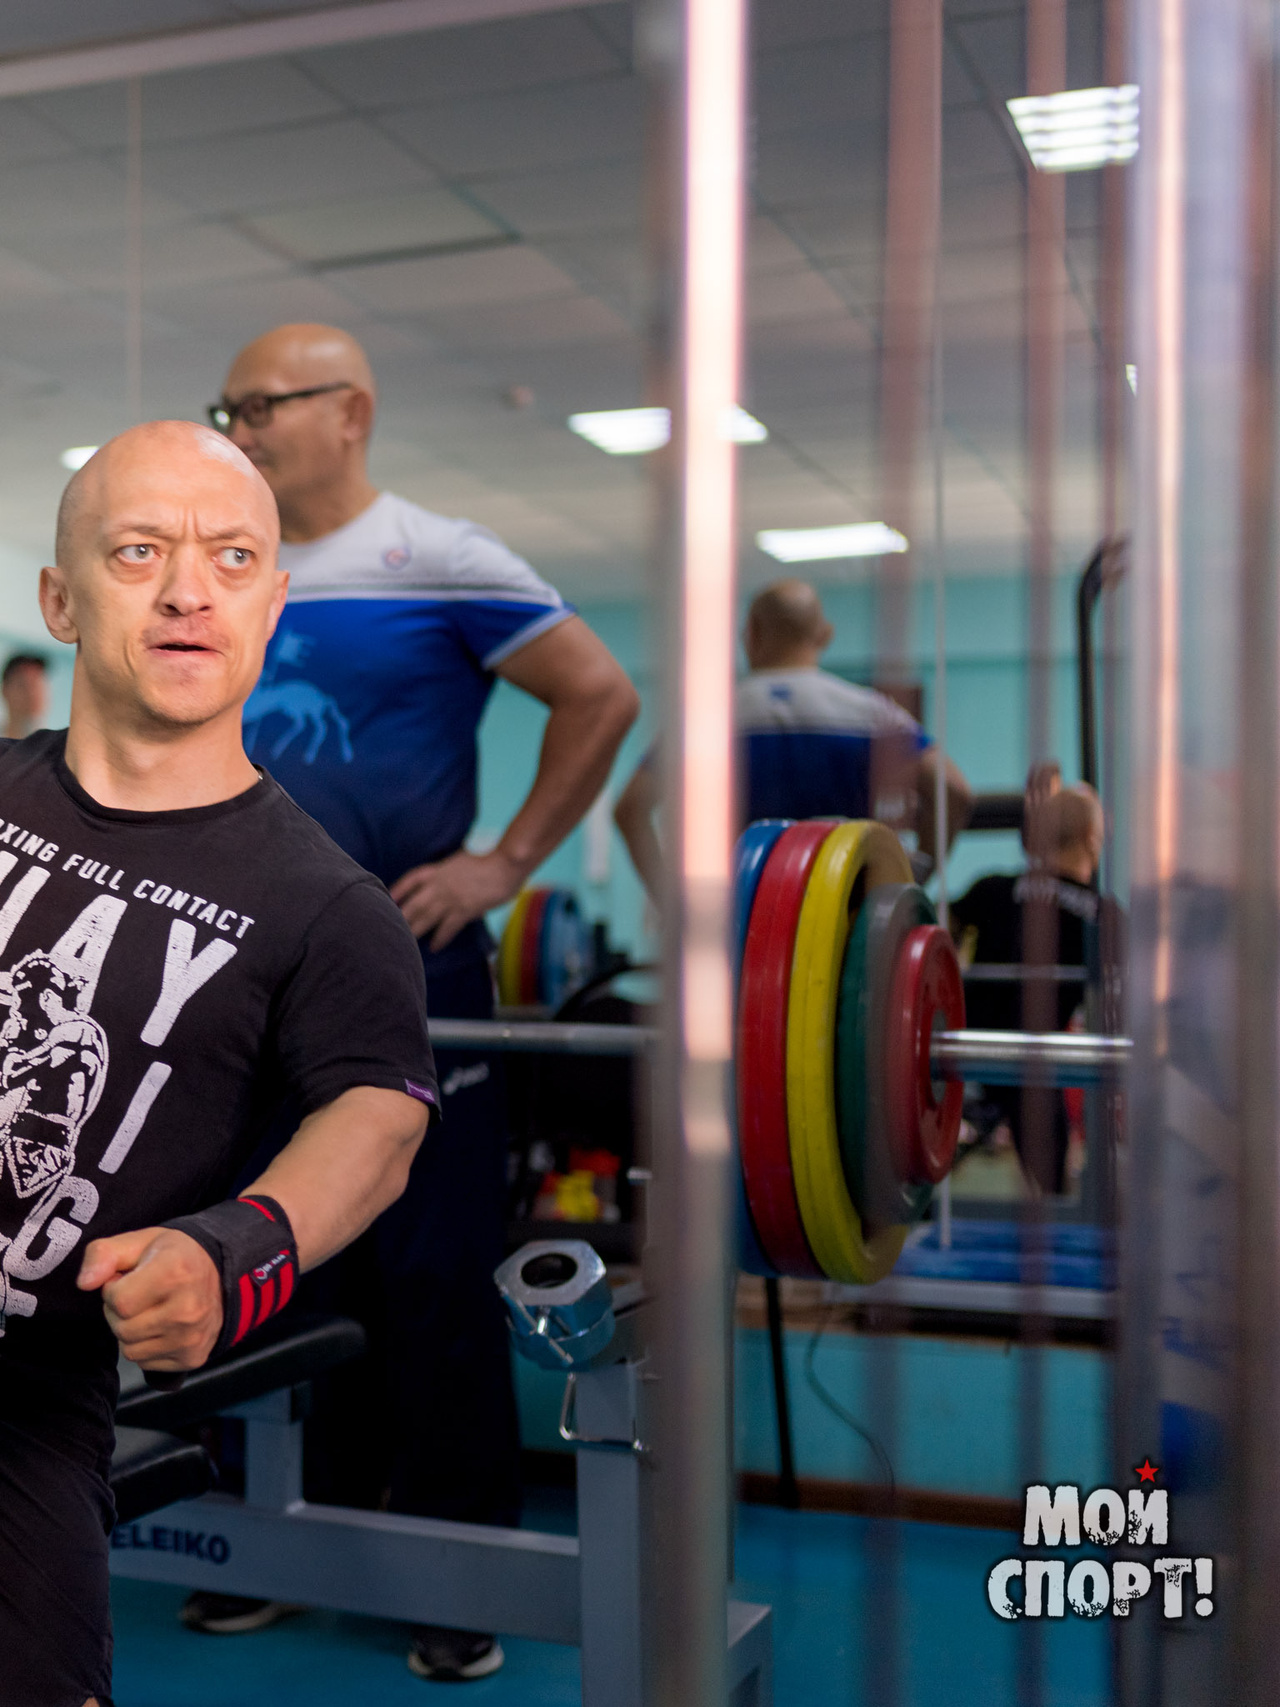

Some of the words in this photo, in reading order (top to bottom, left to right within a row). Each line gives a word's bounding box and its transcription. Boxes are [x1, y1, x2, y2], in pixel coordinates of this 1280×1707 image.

[62, 853, 125, 891] FULL
[133, 878, 255, 940] CONTACT
[110, 1524, 231, 1566] ELEIKO
